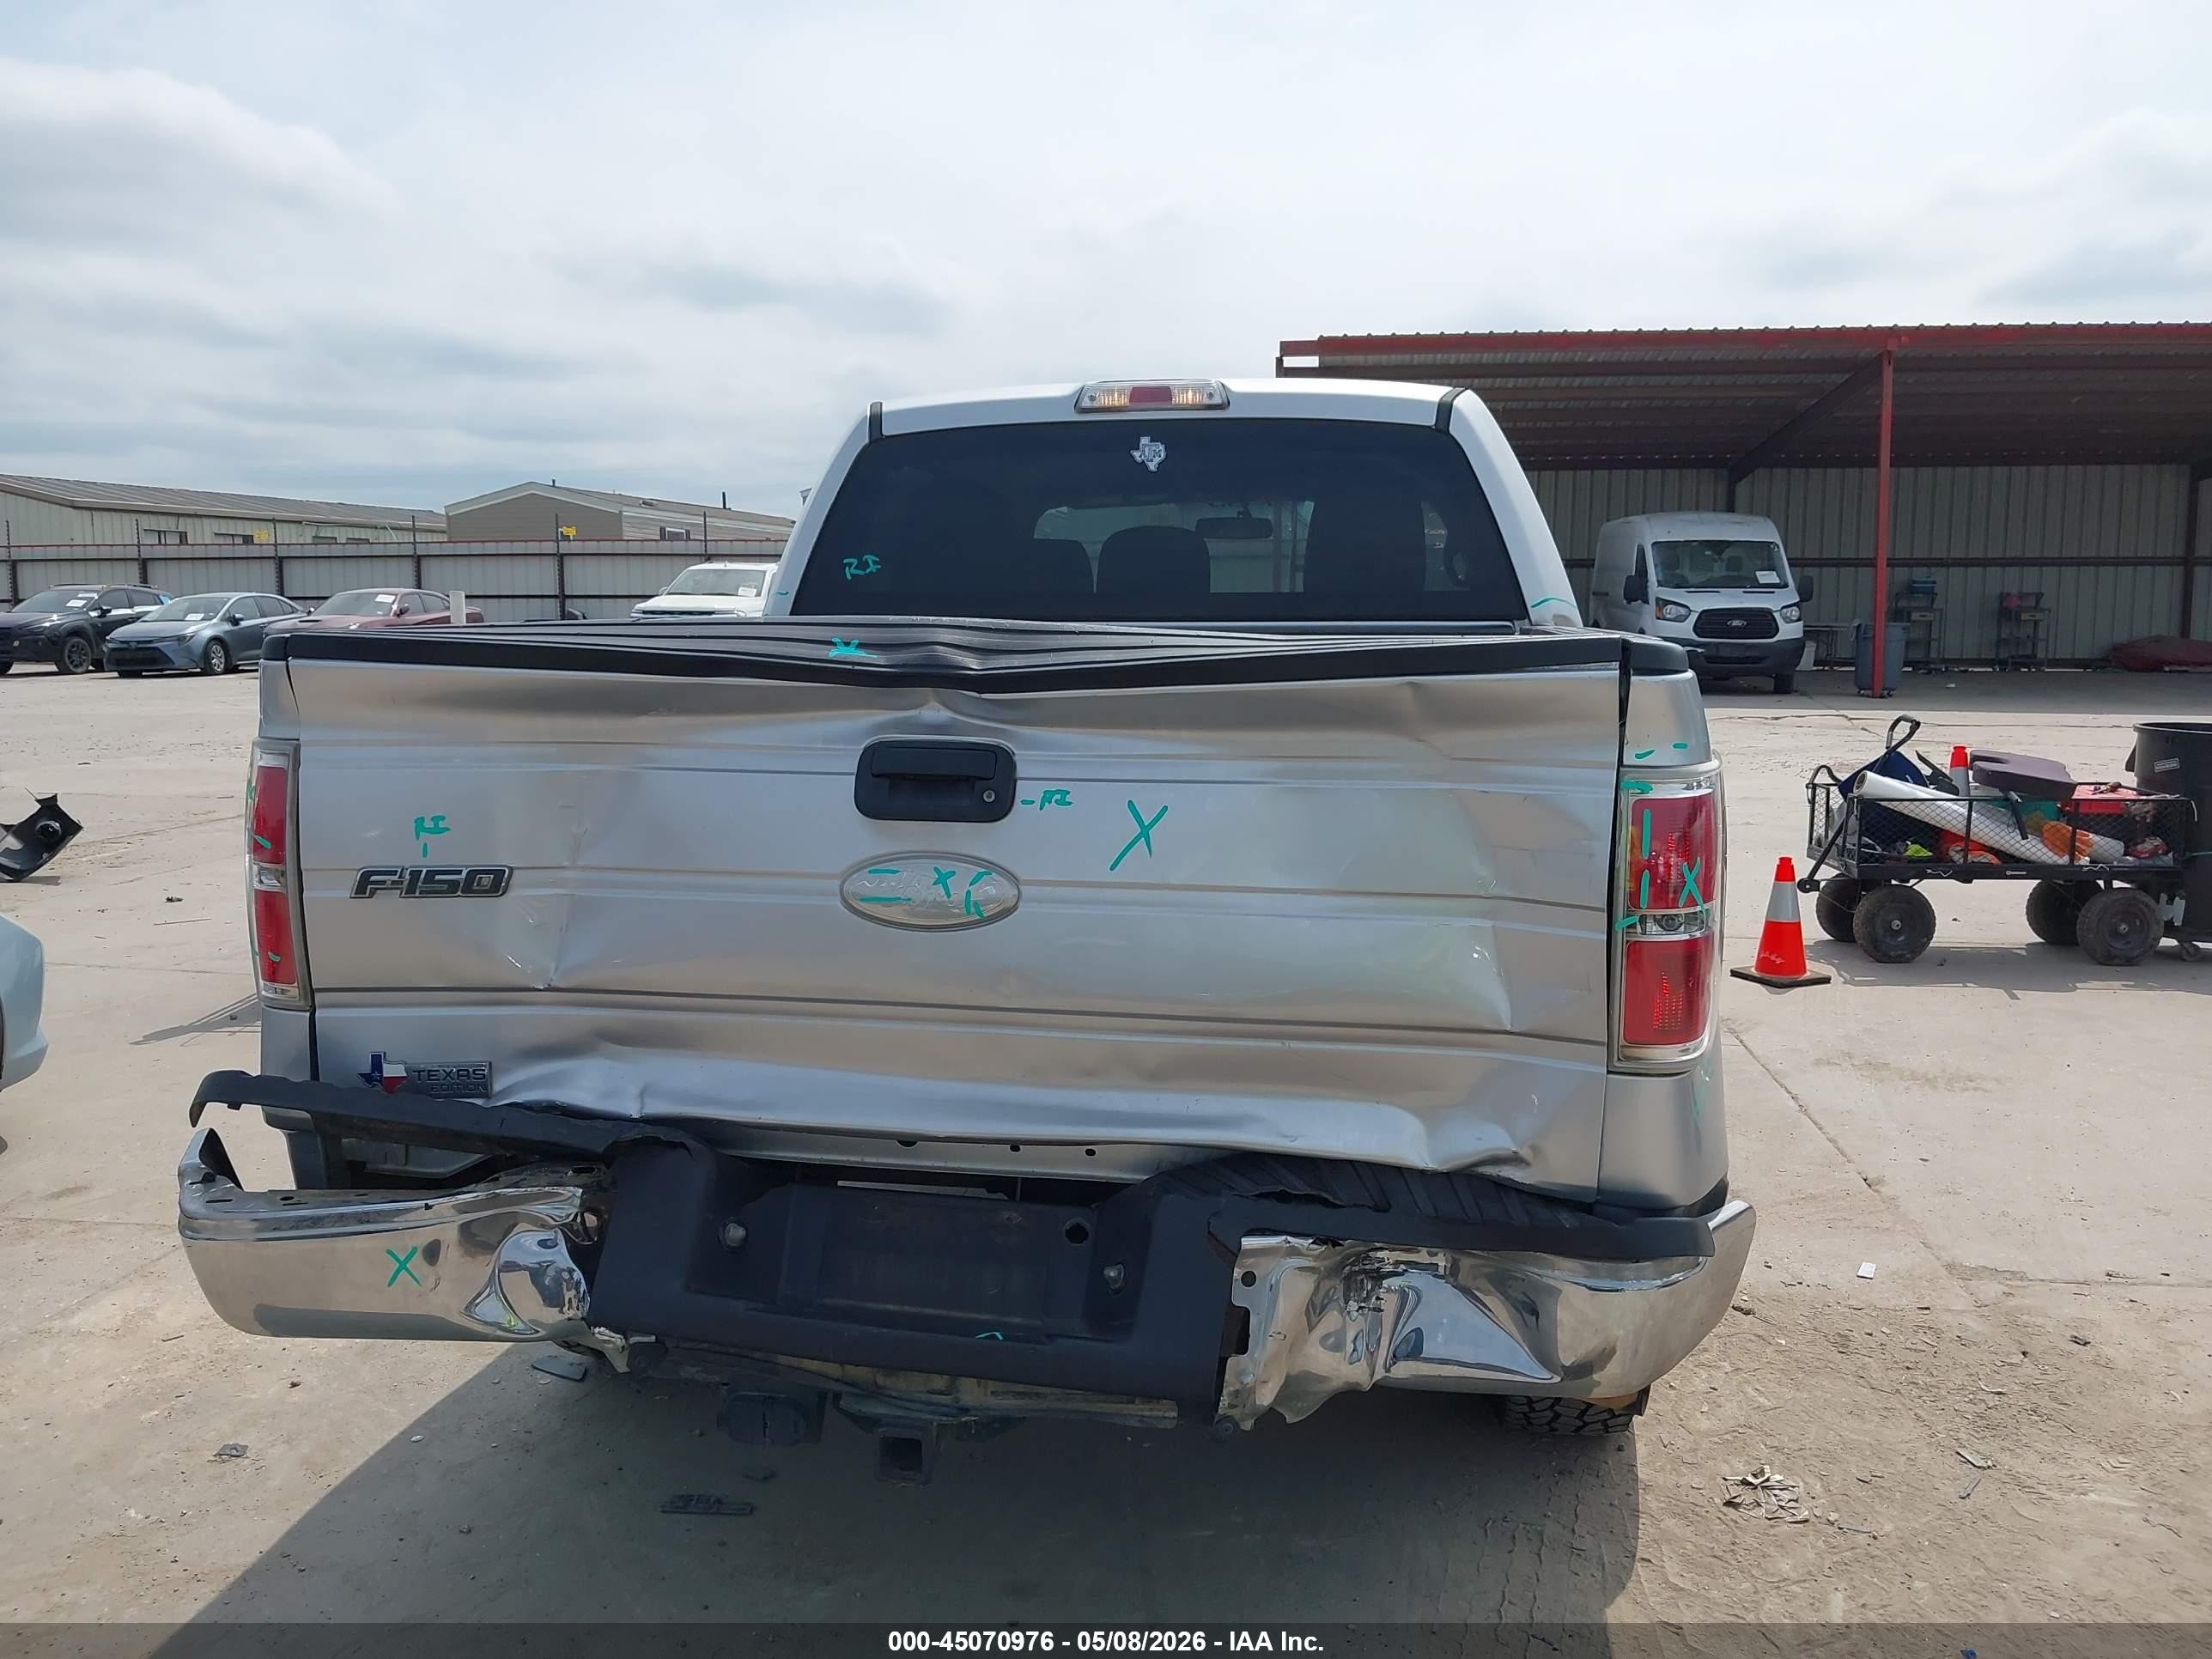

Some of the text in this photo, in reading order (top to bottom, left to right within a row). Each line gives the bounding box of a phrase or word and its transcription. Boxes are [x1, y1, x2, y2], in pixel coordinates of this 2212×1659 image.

[1109, 799, 1169, 871] X
[349, 866, 515, 898] F-150
[413, 1068, 487, 1082] TEXAS
[430, 1083, 488, 1094] EDITION
[386, 1246, 422, 1286] X
